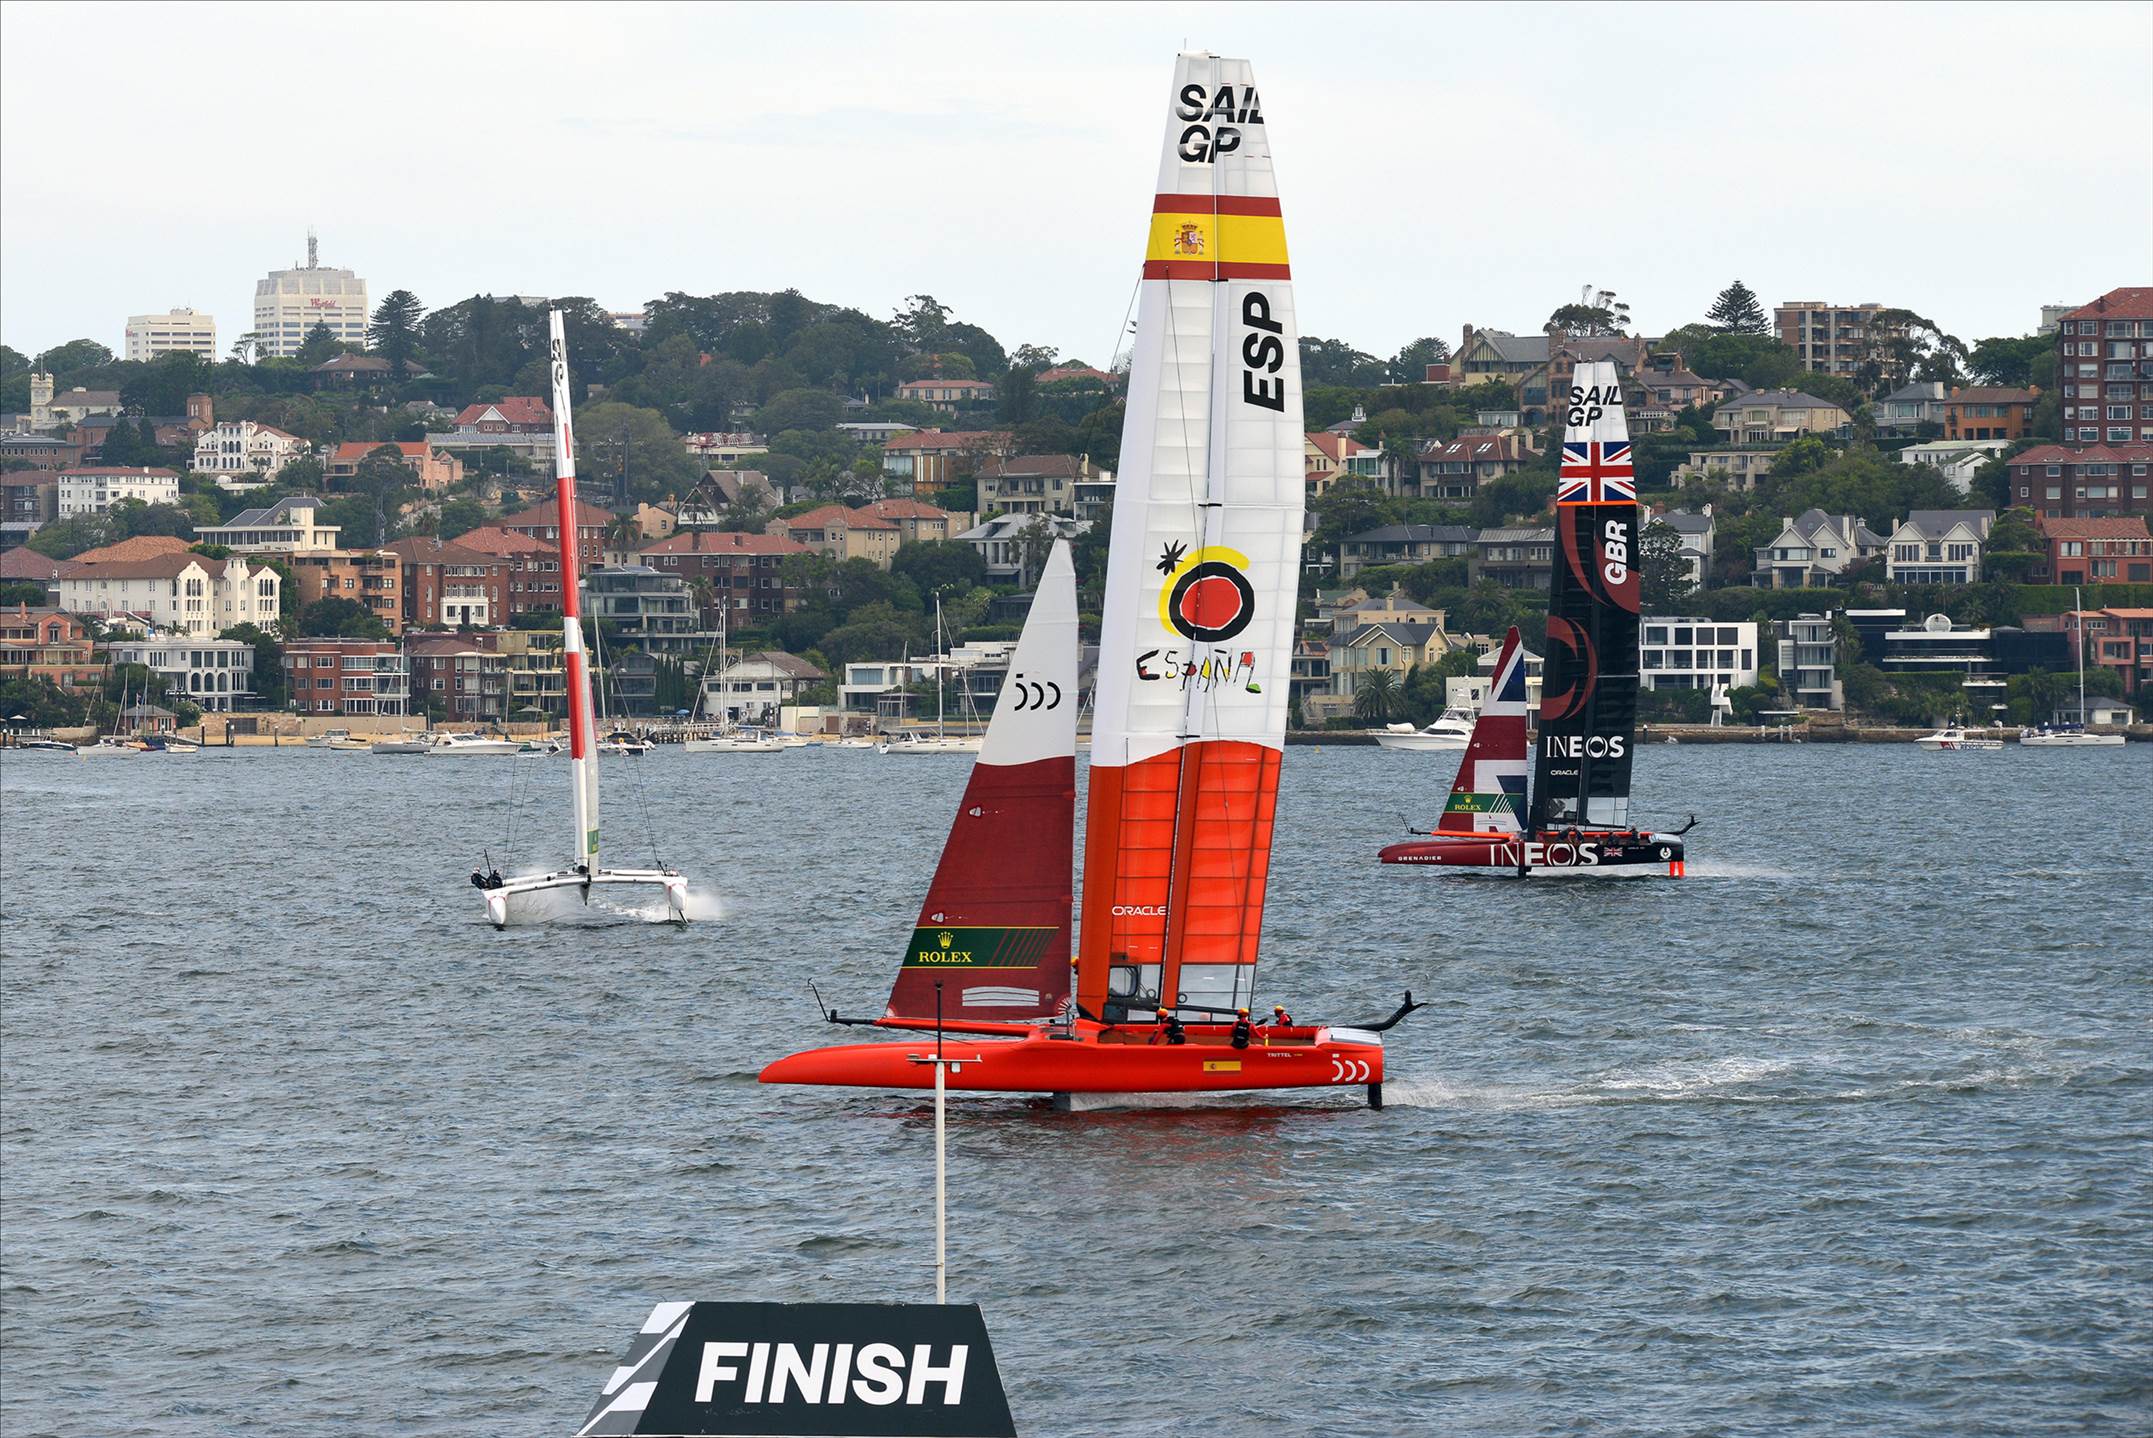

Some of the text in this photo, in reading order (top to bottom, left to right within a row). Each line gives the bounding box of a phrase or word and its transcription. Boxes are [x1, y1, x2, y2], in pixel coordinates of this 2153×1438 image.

[1176, 84, 1264, 124] SAIL
[1177, 125, 1241, 163] GP
[1242, 291, 1284, 413] ESP
[1569, 385, 1623, 406] SAIL
[1567, 407, 1603, 427] GP
[1604, 519, 1627, 585] GBR
[1136, 649, 1262, 694] ESPAÑA
[1546, 735, 1625, 758] INEOS
[1489, 843, 1599, 867] INEOS
[1111, 905, 1167, 916] ORACLE
[918, 951, 973, 963] ROLEX
[694, 1341, 969, 1405] FINISH
